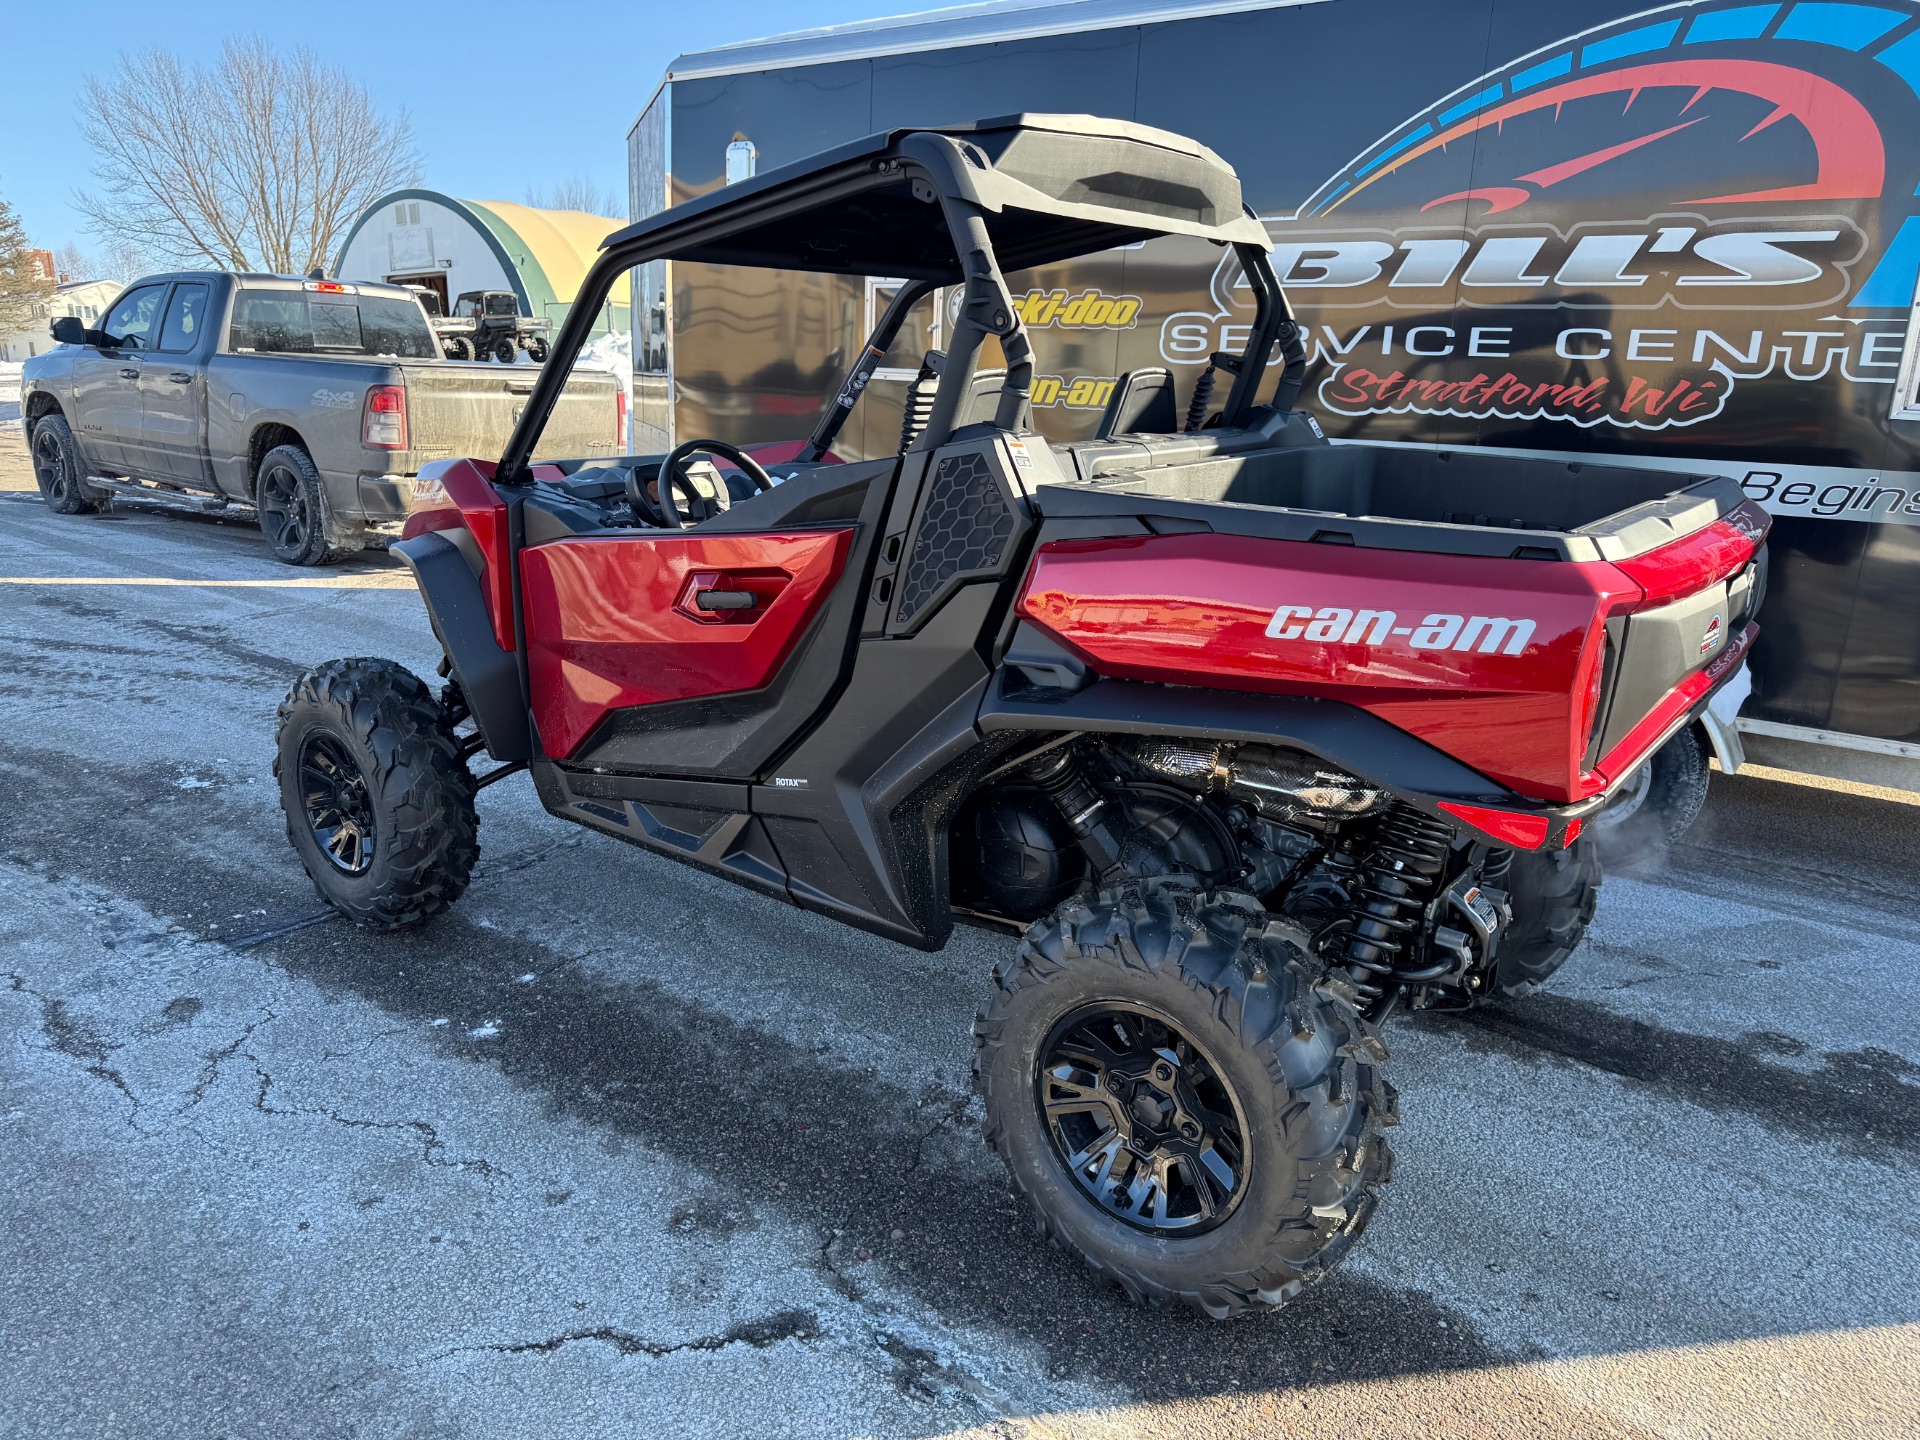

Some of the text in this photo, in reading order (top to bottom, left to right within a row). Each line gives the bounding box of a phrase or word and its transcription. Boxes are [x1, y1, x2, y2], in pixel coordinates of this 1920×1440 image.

[1233, 227, 1841, 289] BILL'S
[1331, 368, 1717, 416] Stratford, Wi
[1264, 604, 1537, 656] can-am
[775, 777, 799, 787] ROTAX
